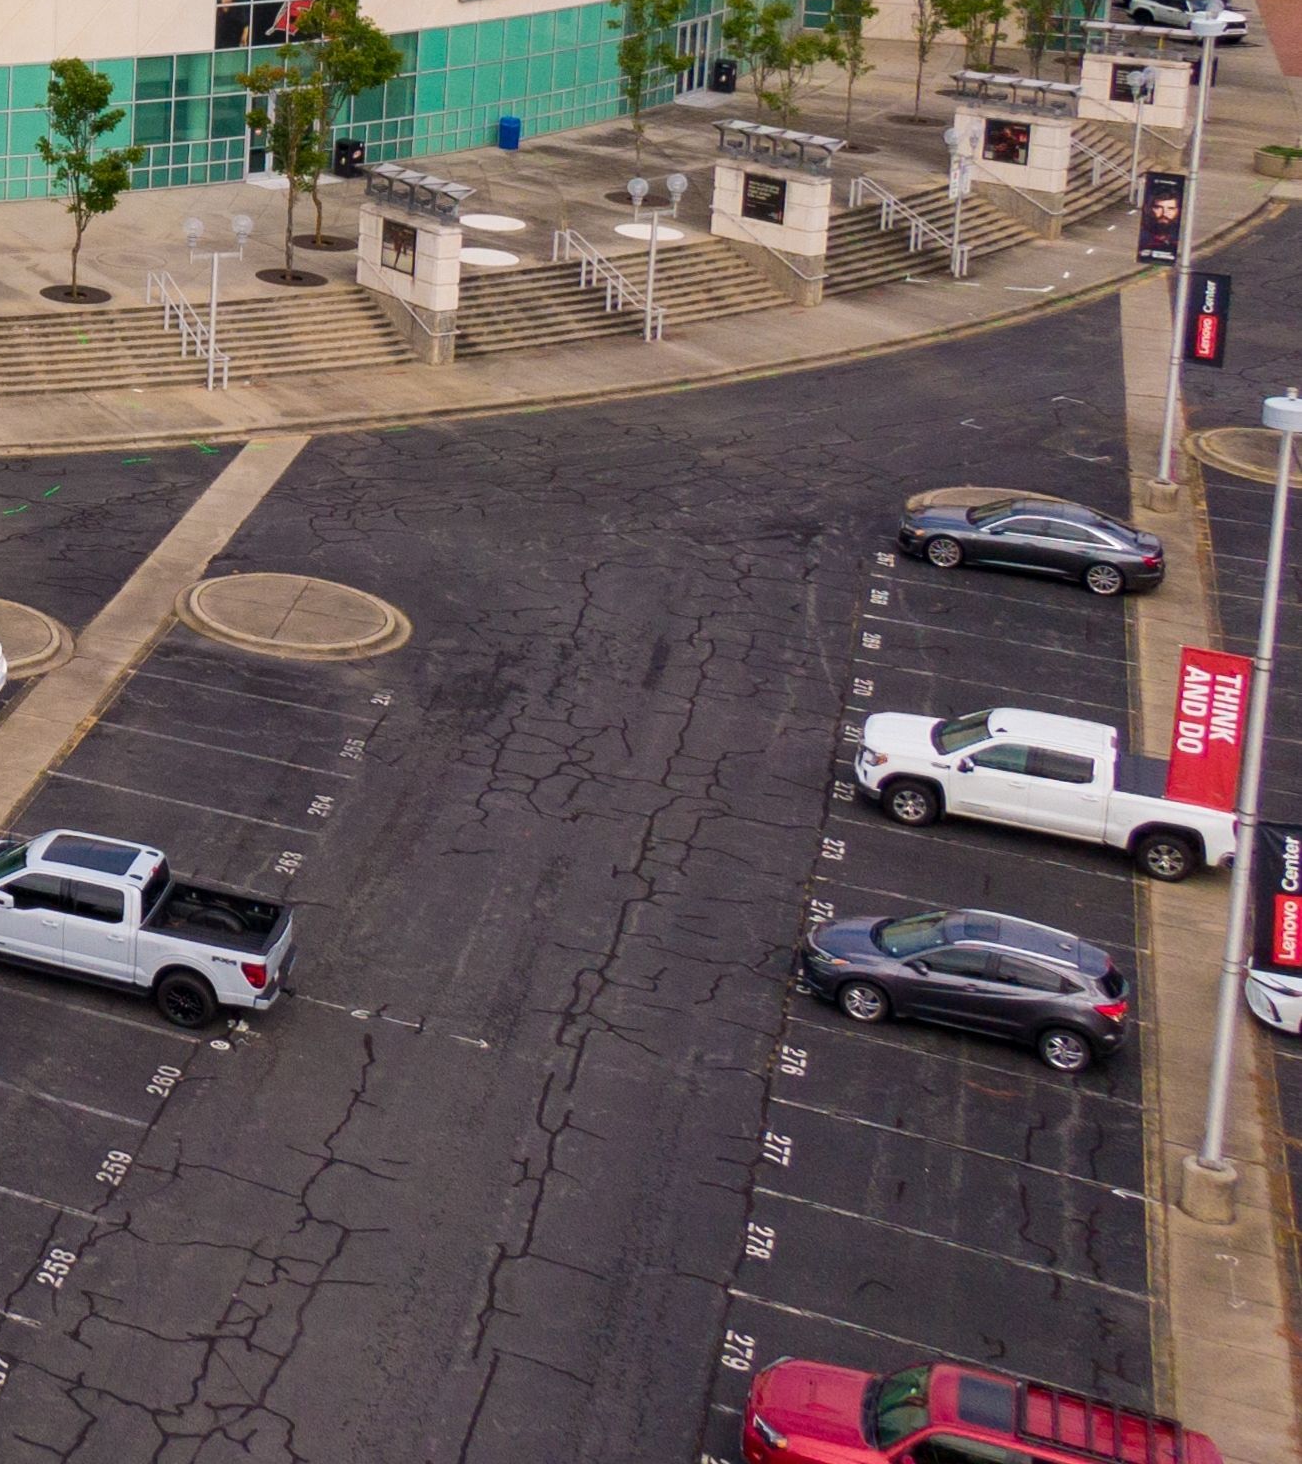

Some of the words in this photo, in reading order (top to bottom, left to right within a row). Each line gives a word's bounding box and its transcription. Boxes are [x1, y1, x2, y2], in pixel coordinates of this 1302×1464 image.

[1202, 280, 1217, 313] Center
[1199, 318, 1213, 355] Lenovo
[852, 677, 874, 697] 270
[1180, 664, 1211, 718] AND
[1208, 674, 1242, 745] THINK
[1176, 720, 1205, 754] DO
[306, 794, 335, 817] 264
[832, 780, 855, 801] 272
[274, 851, 303, 875] 263
[821, 837, 846, 861] 273
[1281, 836, 1302, 892] Center
[1278, 900, 1298, 960] Lenovo
[780, 1045, 808, 1076] 276
[145, 1065, 182, 1098] 260
[762, 1131, 792, 1166] 277
[95, 1150, 133, 1186] 259
[745, 1222, 775, 1259] 278
[36, 1248, 76, 1288] 258
[721, 1329, 756, 1371] 279
